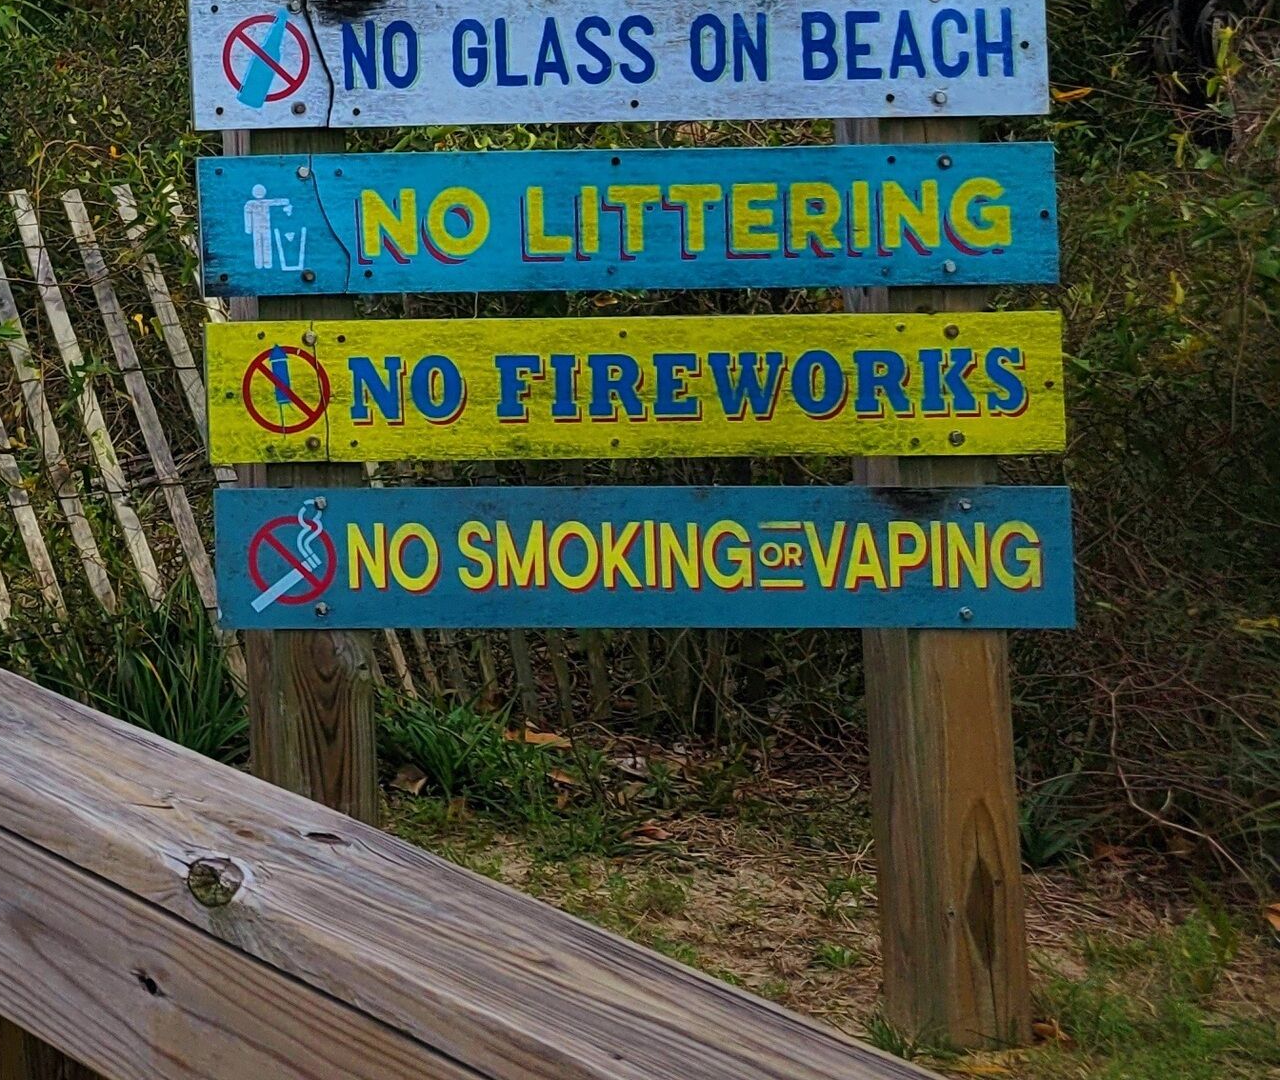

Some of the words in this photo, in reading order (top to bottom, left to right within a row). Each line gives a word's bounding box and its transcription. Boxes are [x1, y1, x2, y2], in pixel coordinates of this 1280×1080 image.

[341, 18, 421, 90] NO
[452, 15, 656, 87] GLASS
[690, 11, 769, 83] ON
[802, 6, 1016, 81] BEACH
[354, 187, 491, 265] NO
[521, 178, 1013, 263] LITTERING
[349, 354, 468, 425] NO
[494, 346, 1029, 423] FIREWORKS
[347, 522, 440, 593] NO
[457, 519, 755, 592] SMOKING
[759, 541, 803, 568] OR
[803, 520, 1042, 592] VAPING
